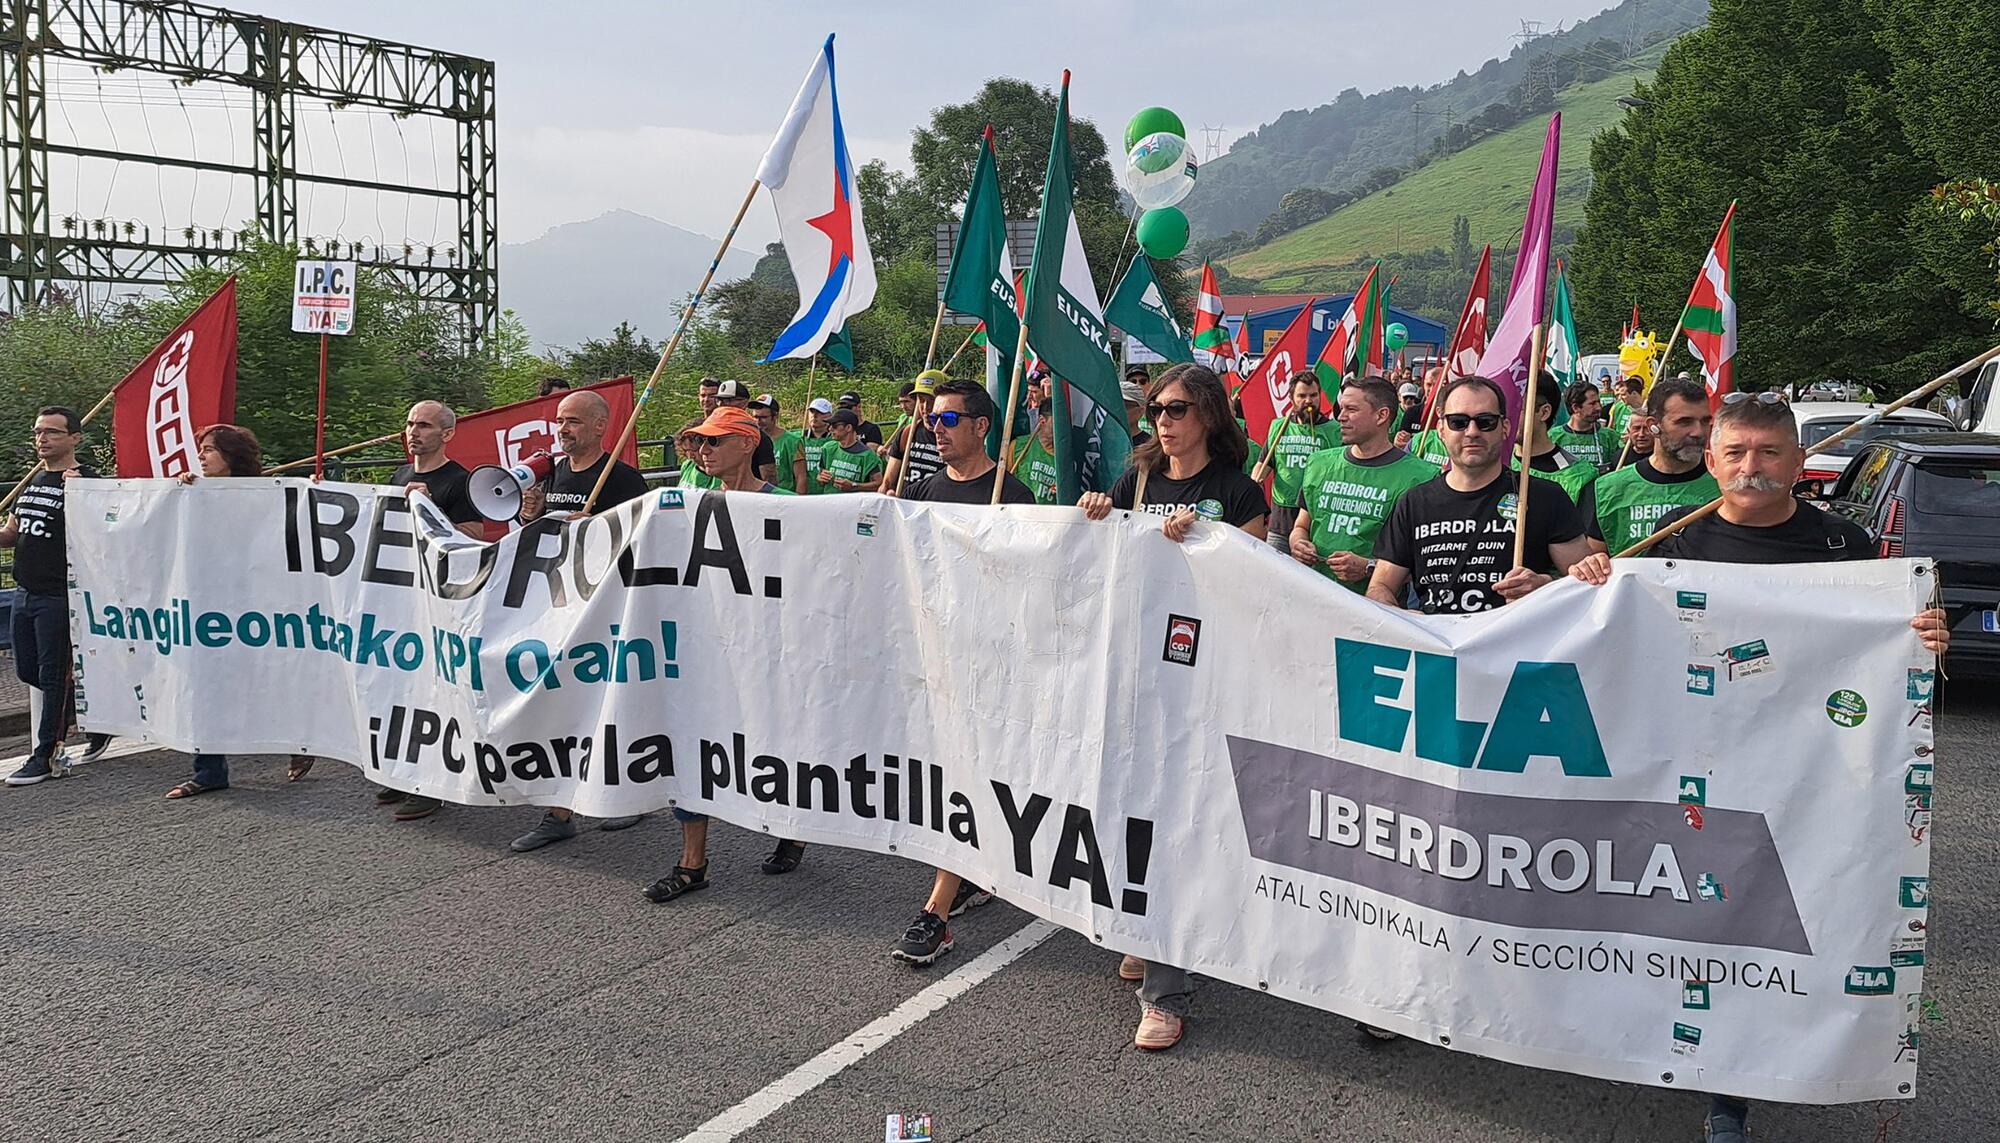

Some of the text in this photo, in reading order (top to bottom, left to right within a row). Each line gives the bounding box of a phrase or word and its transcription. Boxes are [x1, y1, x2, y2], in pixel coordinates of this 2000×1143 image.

[299, 267, 350, 294] I.P.C.
[309, 310, 336, 329] ¡YA!
[1057, 293, 1114, 362] EUSKA
[1031, 461, 1056, 477] IBERD
[1286, 454, 1308, 468] IPC
[1322, 481, 1388, 501] IBERDROLA
[1318, 495, 1383, 519] SI QUEREMOS EL
[1327, 513, 1361, 536] IPC
[1630, 523, 1641, 538] SI
[285, 487, 782, 609] IBERDROLA:
[1420, 542, 1505, 555] HITZARME DUIN
[1426, 557, 1457, 567] BATEN
[84, 591, 424, 671] Langileontzako
[432, 625, 484, 692] KPI
[1171, 641, 1191, 652] CGT
[1335, 637, 1612, 778] ELA
[369, 705, 1154, 917] ¡IPC para la plantilla YA!
[1308, 789, 1693, 903] IBERDROLA
[1255, 874, 1808, 996] ATAL SINDIKALA / SECCIÓN SINDICAL
[1850, 971, 1888, 987] ELA
